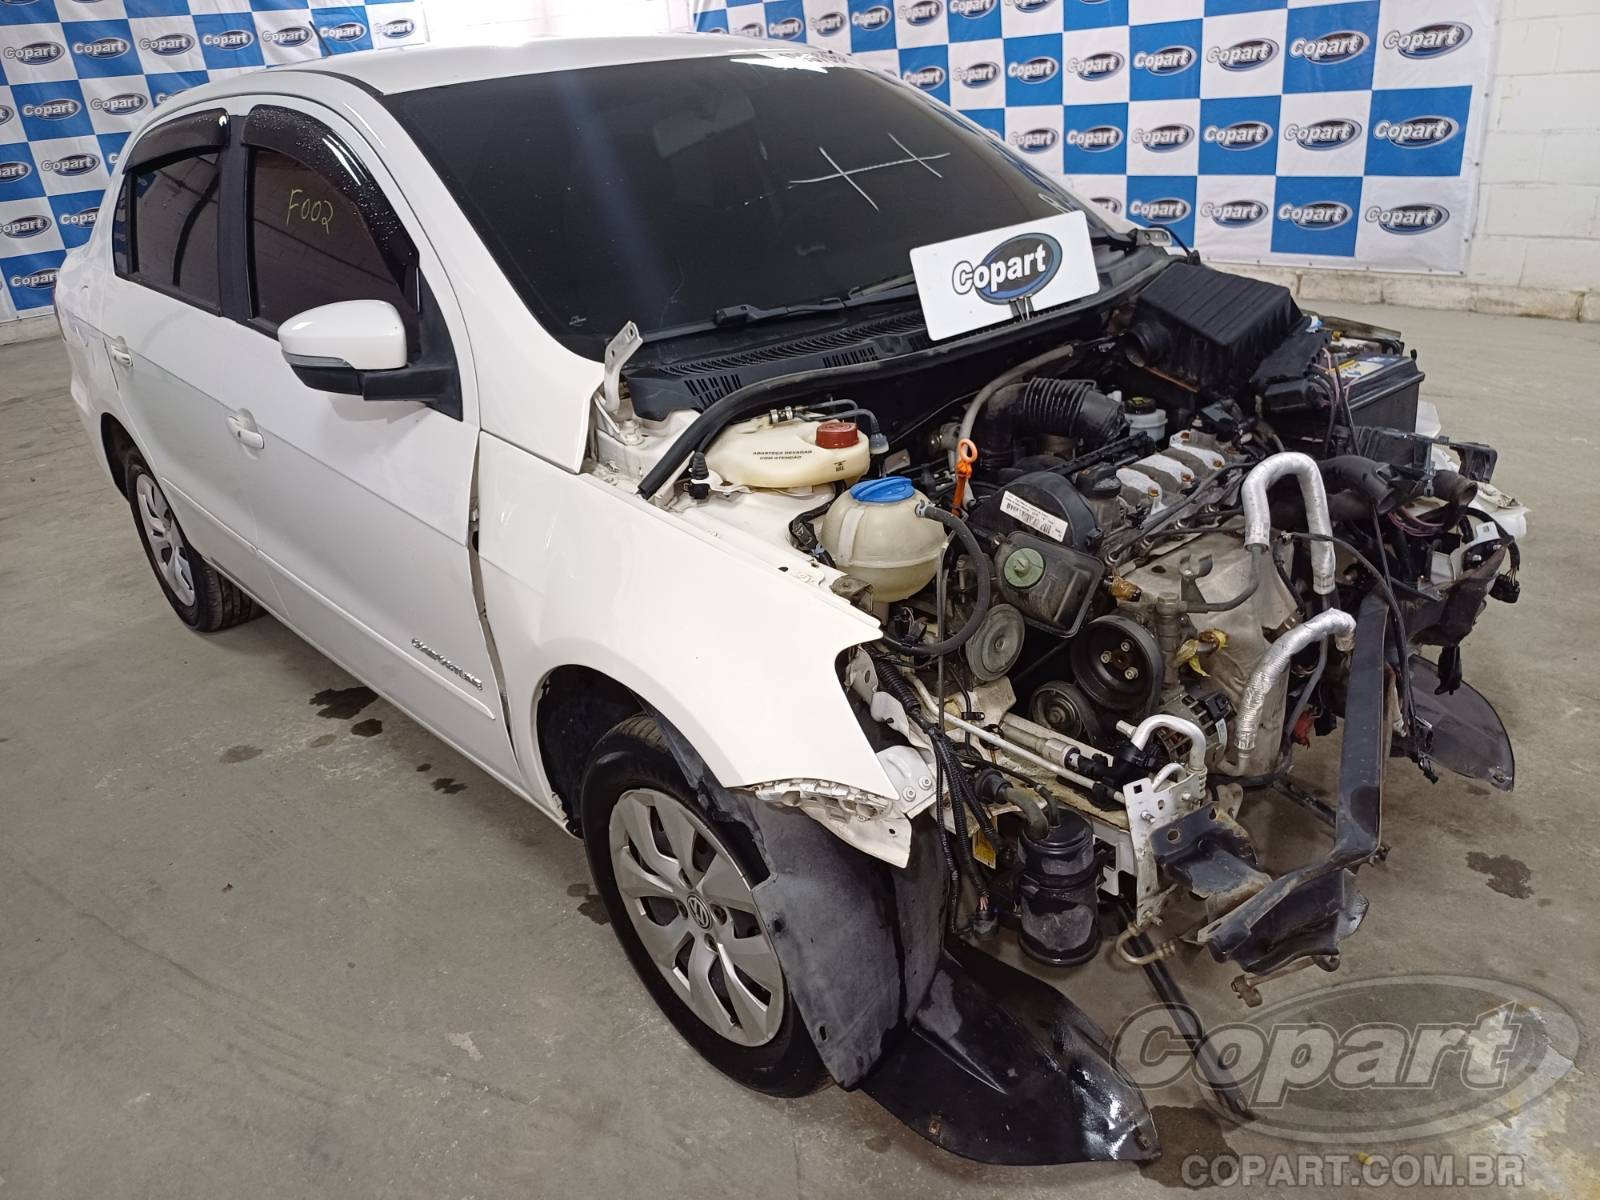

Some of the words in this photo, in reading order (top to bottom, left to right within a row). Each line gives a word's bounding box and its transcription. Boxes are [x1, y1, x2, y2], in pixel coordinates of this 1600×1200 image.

[898, 3, 937, 21] Copart
[263, 29, 306, 46] Copart
[320, 24, 361, 40] Copart
[374, 21, 412, 37] Copart
[73, 40, 124, 57] Copart
[139, 36, 187, 54] Copart
[203, 32, 248, 49] Copart
[1290, 34, 1359, 62] Copart
[1384, 26, 1460, 54] Copart
[4, 43, 57, 61] Copart
[1134, 49, 1188, 70] Copart
[1207, 43, 1269, 66] Copart
[1008, 61, 1052, 80] Copart
[1067, 54, 1117, 75] Copart
[953, 67, 995, 85] Copart
[22, 102, 73, 118] Copart
[90, 96, 140, 113] Copart
[1008, 131, 1052, 150] Copart
[1067, 129, 1116, 148] Copart
[1132, 126, 1186, 148] Copart
[1203, 123, 1264, 147] Copart
[1284, 122, 1352, 147] Copart
[1374, 118, 1447, 144] Copart
[42, 157, 93, 173] Copart
[1130, 200, 1184, 221] Copart
[1201, 202, 1260, 225] Copart
[1279, 202, 1345, 227] Copart
[1366, 206, 1437, 231] Copart
[0, 218, 43, 236] opart
[952, 243, 1046, 296] Copart
